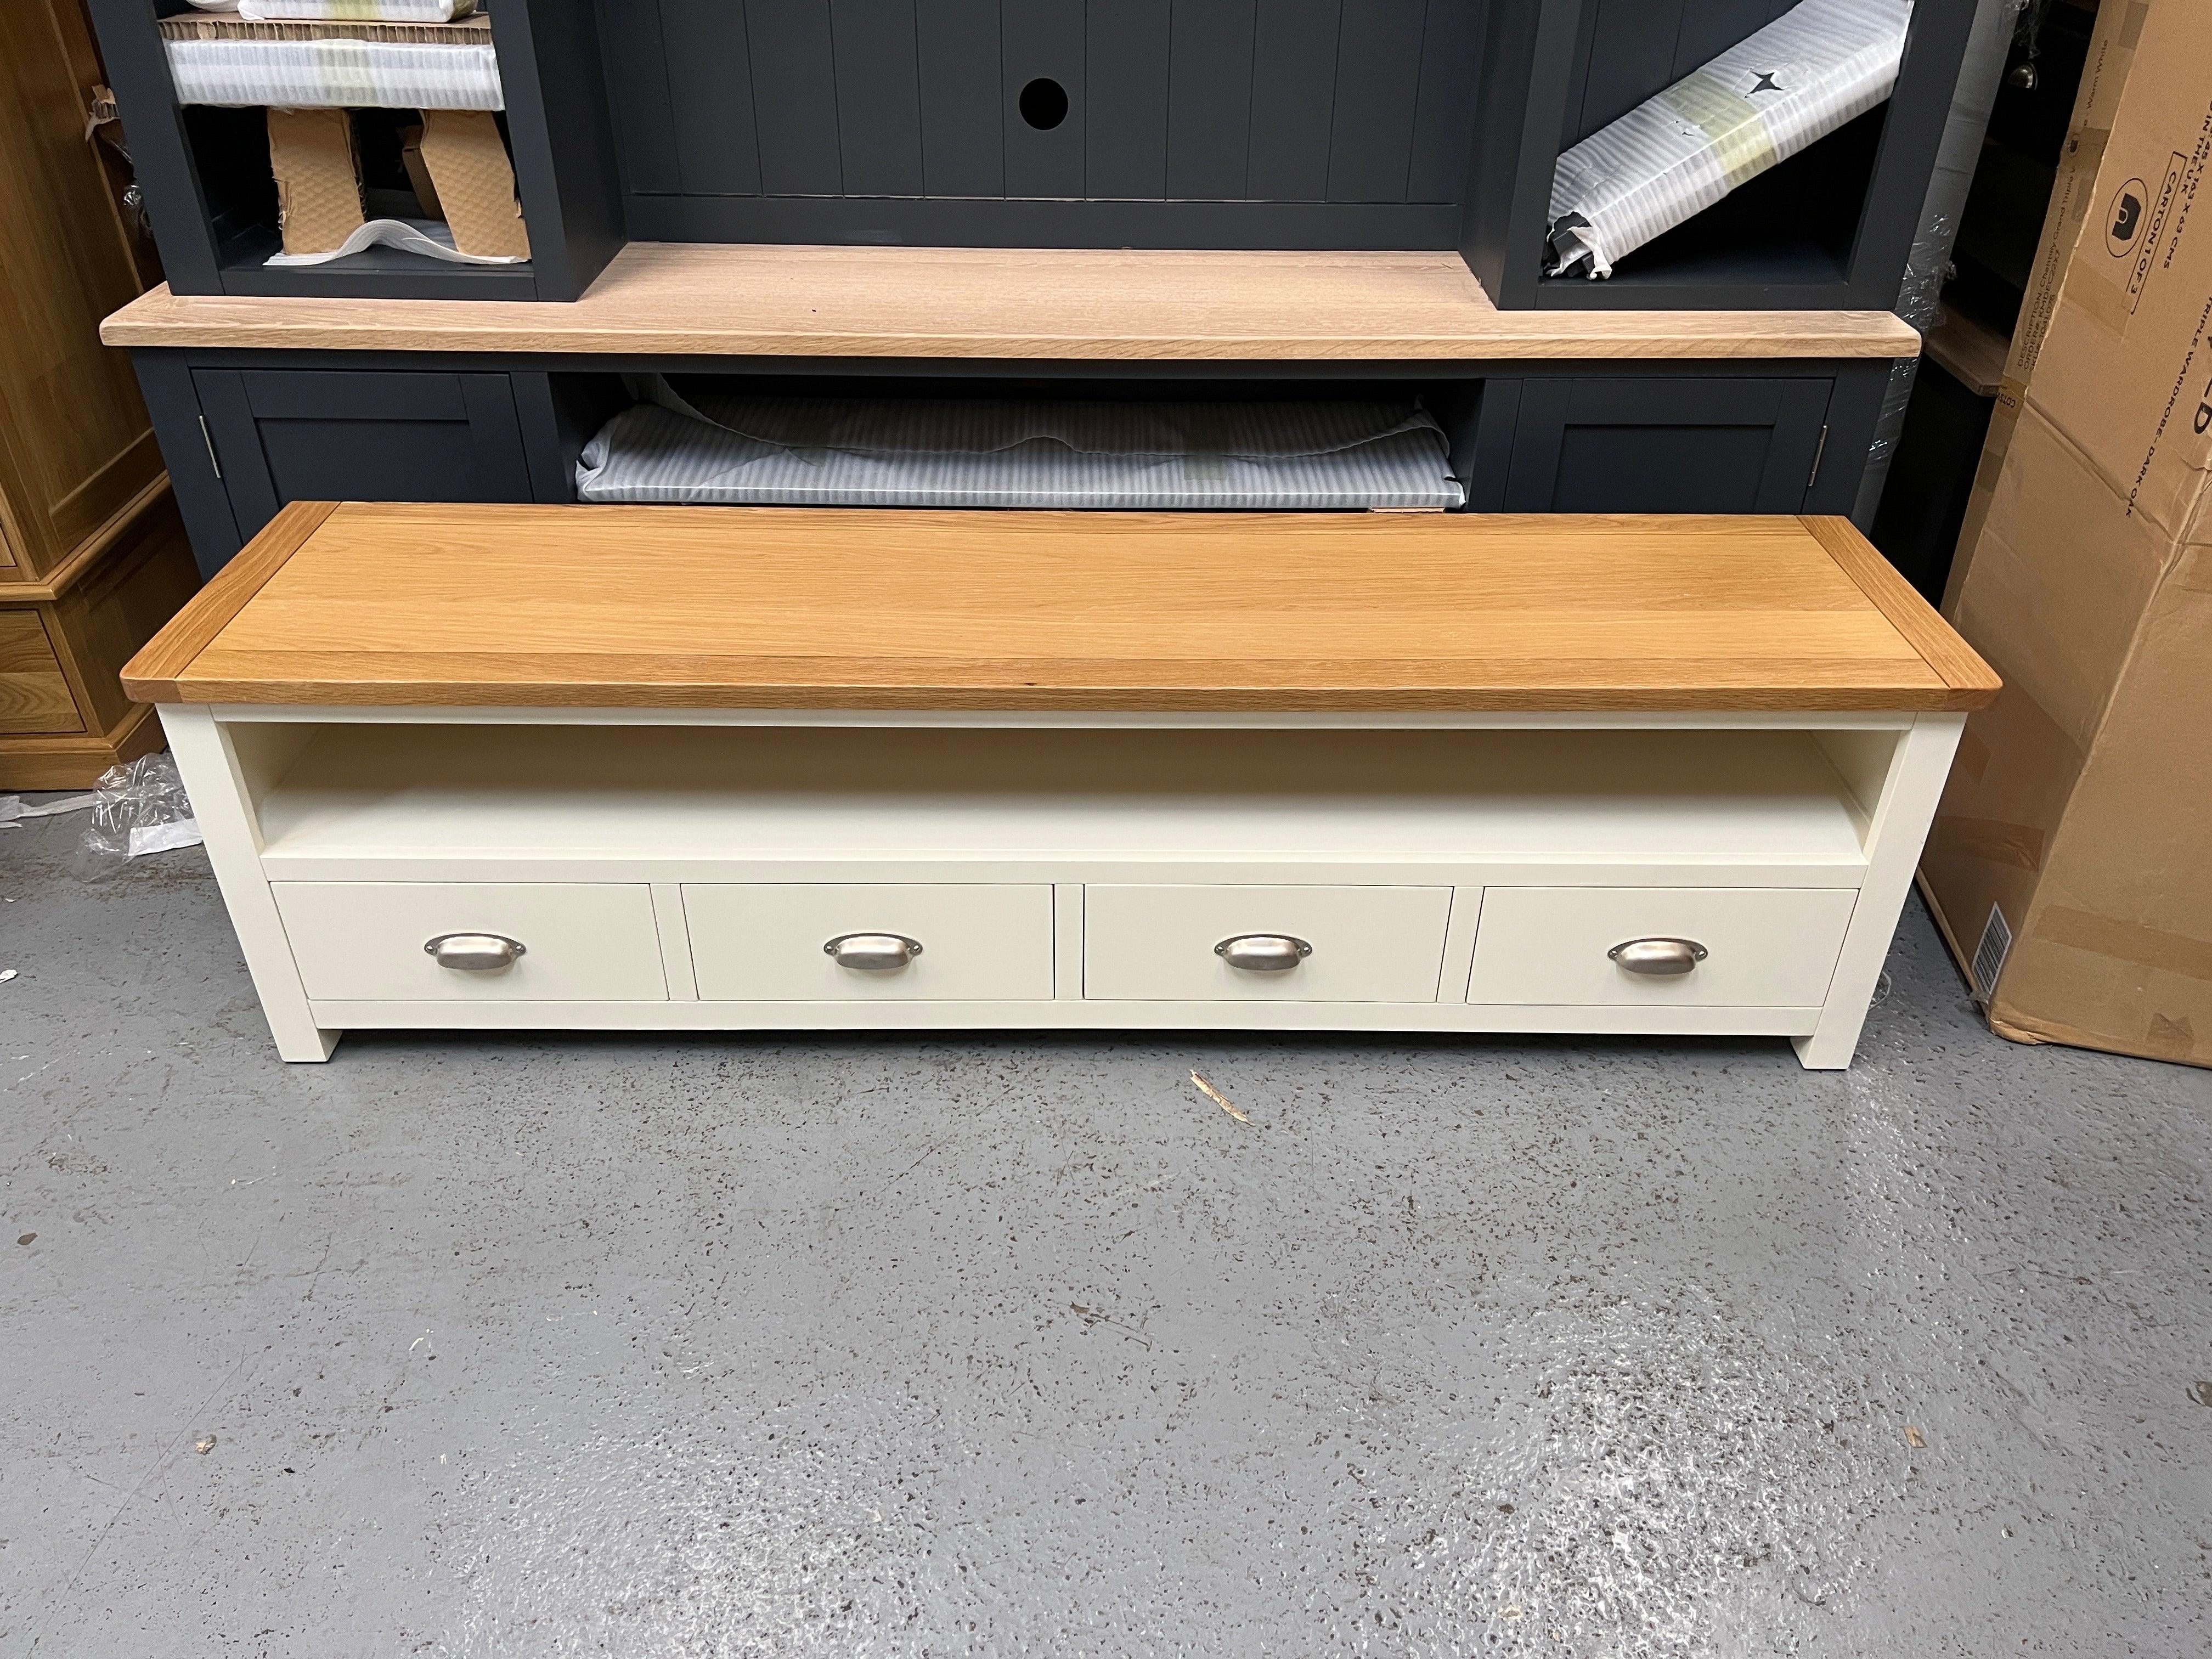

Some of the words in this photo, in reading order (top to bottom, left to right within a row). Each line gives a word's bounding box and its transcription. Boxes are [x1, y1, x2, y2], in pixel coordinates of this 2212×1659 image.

[2202, 115, 2212, 131] IN
[2053, 206, 2066, 240] Grand
[2086, 76, 2099, 109] Warm
[2190, 135, 2207, 166] THE
[2196, 163, 2204, 174] X
[2188, 177, 2199, 200] 163
[2147, 171, 2176, 245] CARTON
[2182, 202, 2191, 214] X
[2176, 216, 2185, 233] 63
[2164, 236, 2178, 269] CMS
[2136, 258, 2147, 283] OF
[2131, 284, 2138, 295] 3
[2136, 446, 2155, 487] DARK
[2126, 487, 2137, 518] OAK
